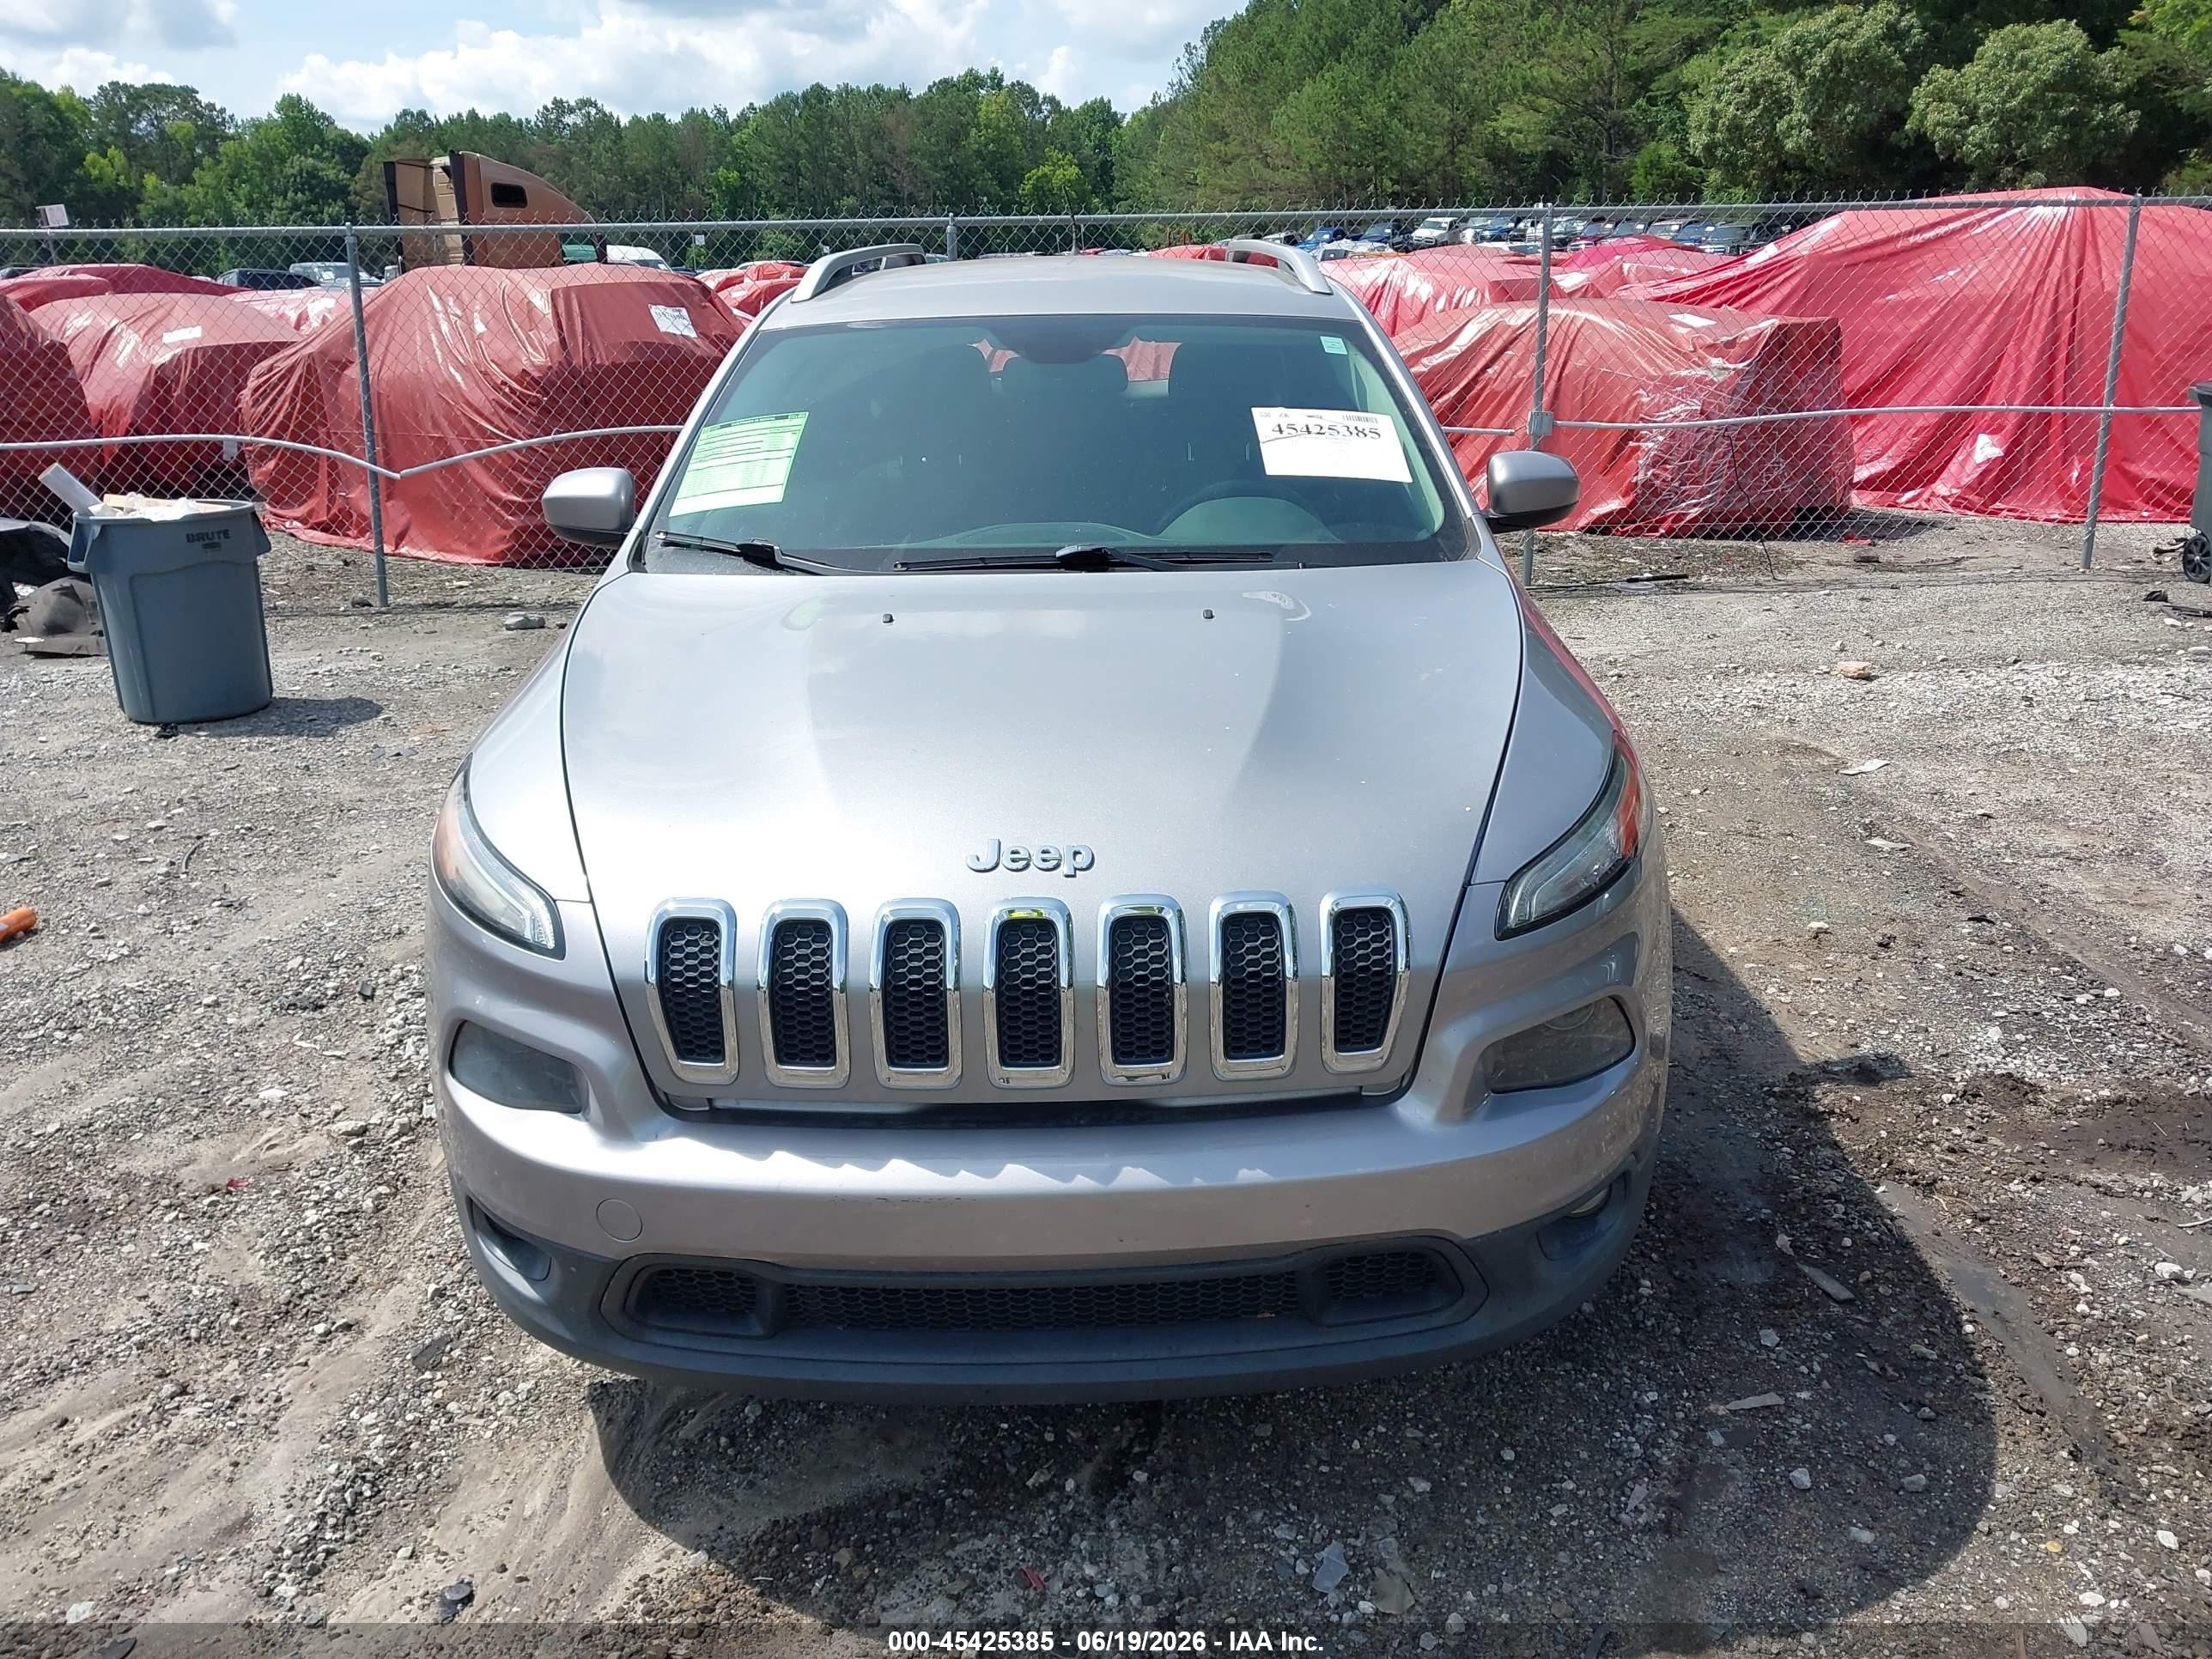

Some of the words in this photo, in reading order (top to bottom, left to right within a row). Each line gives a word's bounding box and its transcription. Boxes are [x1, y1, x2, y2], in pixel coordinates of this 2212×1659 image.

[1272, 423, 1381, 440] 45425385
[185, 529, 231, 544] BRUTE
[966, 838, 1095, 878] Jeep
